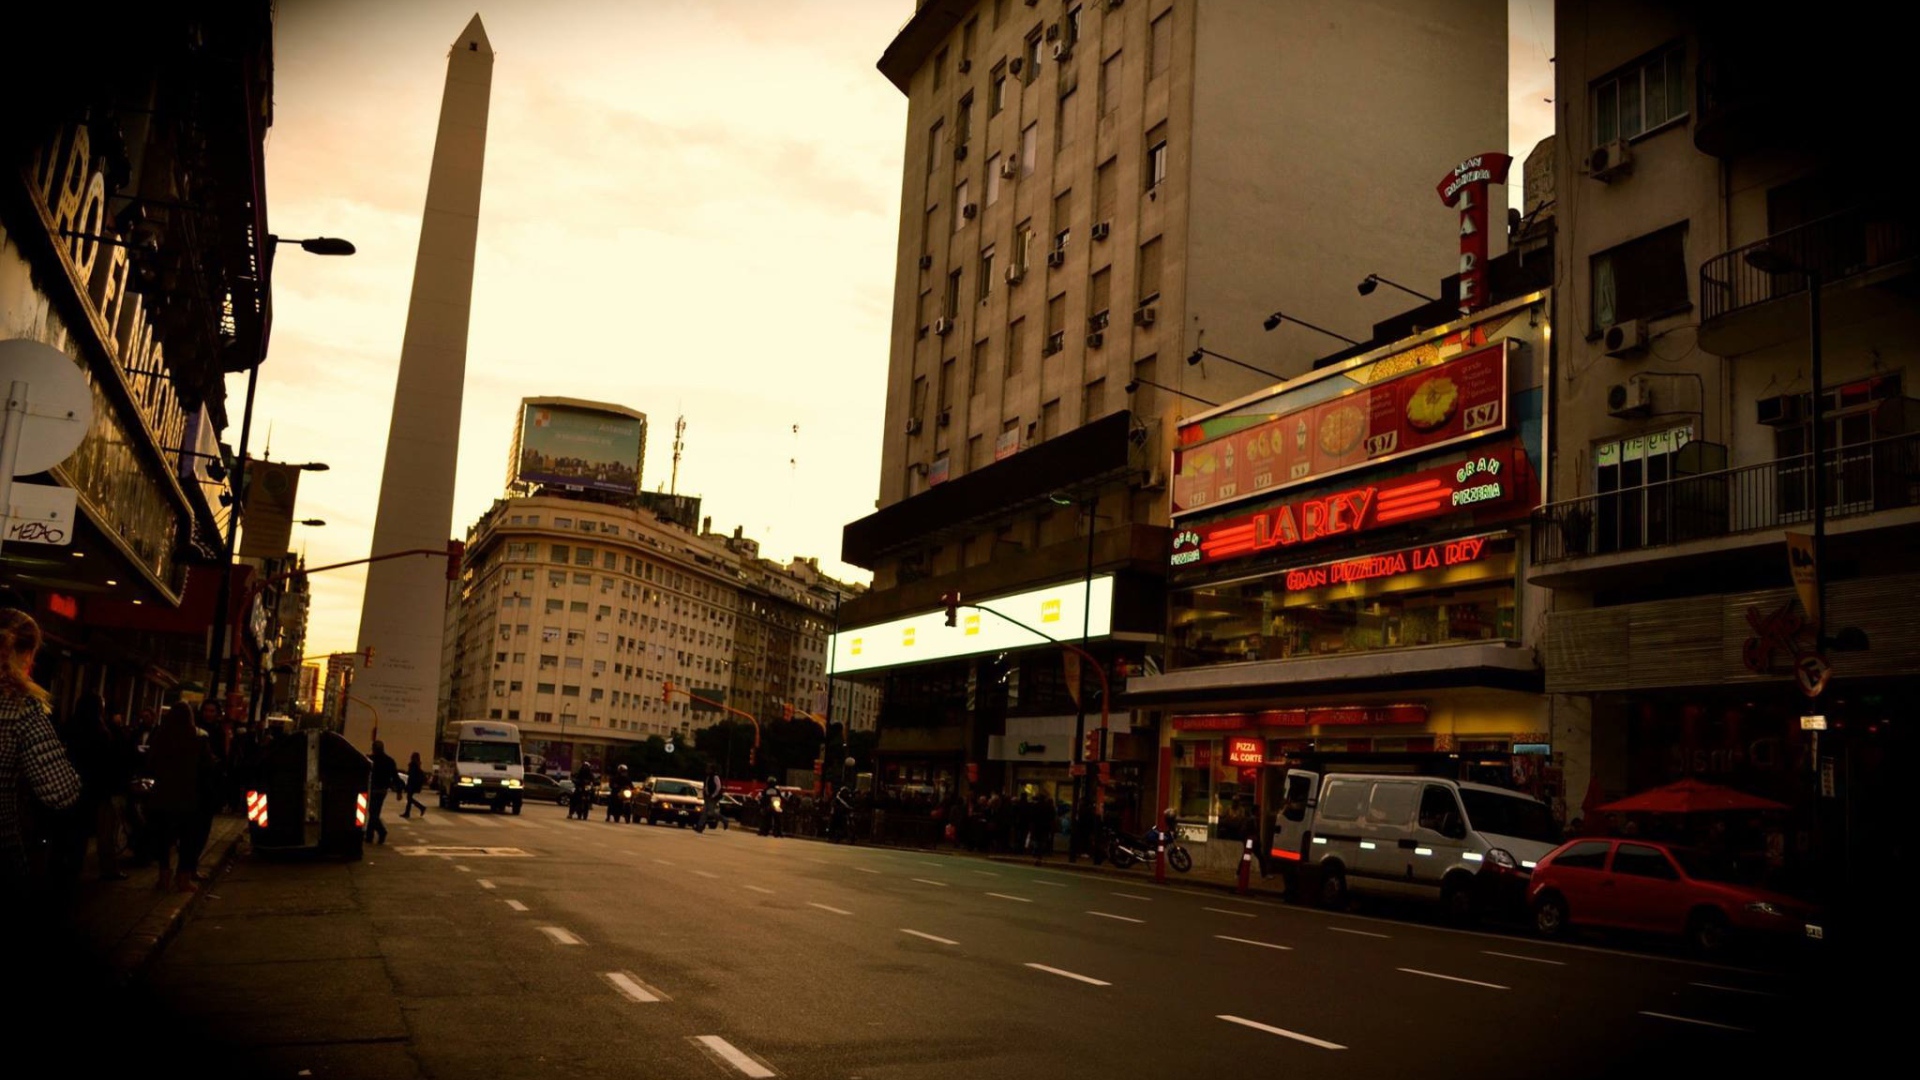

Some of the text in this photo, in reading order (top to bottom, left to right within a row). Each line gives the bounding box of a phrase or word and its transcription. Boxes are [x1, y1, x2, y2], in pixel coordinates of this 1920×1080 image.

[1456, 457, 1500, 483] GRAN
[1452, 482, 1500, 506] PIZZERIA
[1253, 486, 1377, 550] LA REY
[1173, 531, 1199, 549] GRAN
[1171, 549, 1200, 565] PIZZERIA
[1287, 538, 1485, 591] GRAN PIZZERIA LA REY
[1236, 742, 1256, 752] PIZZA
[1230, 753, 1263, 763] AL CORTE
